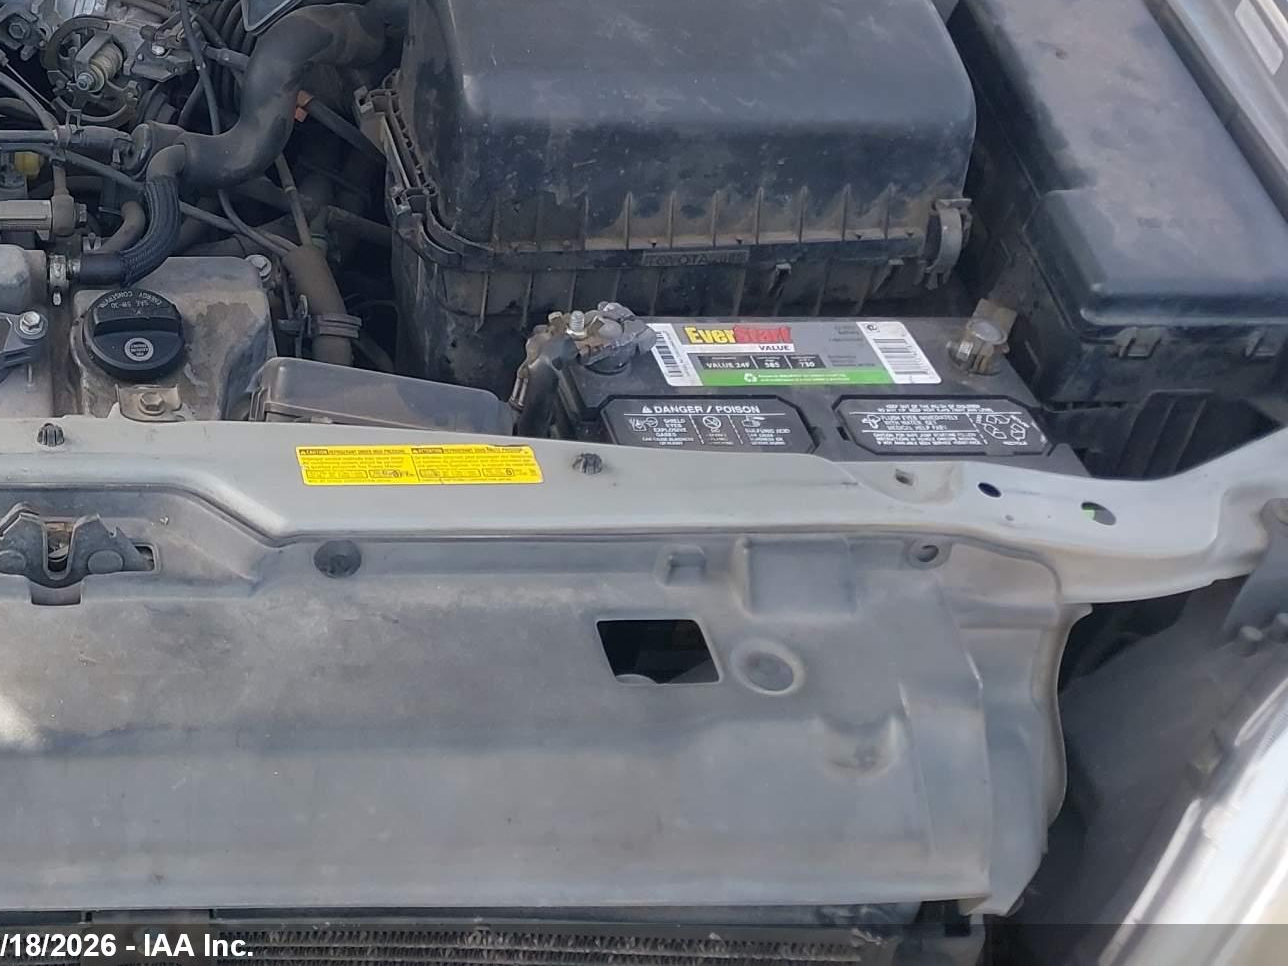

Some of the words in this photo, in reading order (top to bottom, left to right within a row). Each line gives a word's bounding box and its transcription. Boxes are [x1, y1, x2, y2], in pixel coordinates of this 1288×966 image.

[647, 253, 709, 266] TOYOTA
[683, 325, 792, 344] EverStart
[706, 361, 733, 369] VALUE
[653, 405, 704, 414] DANGER
[715, 405, 761, 414] POISON
